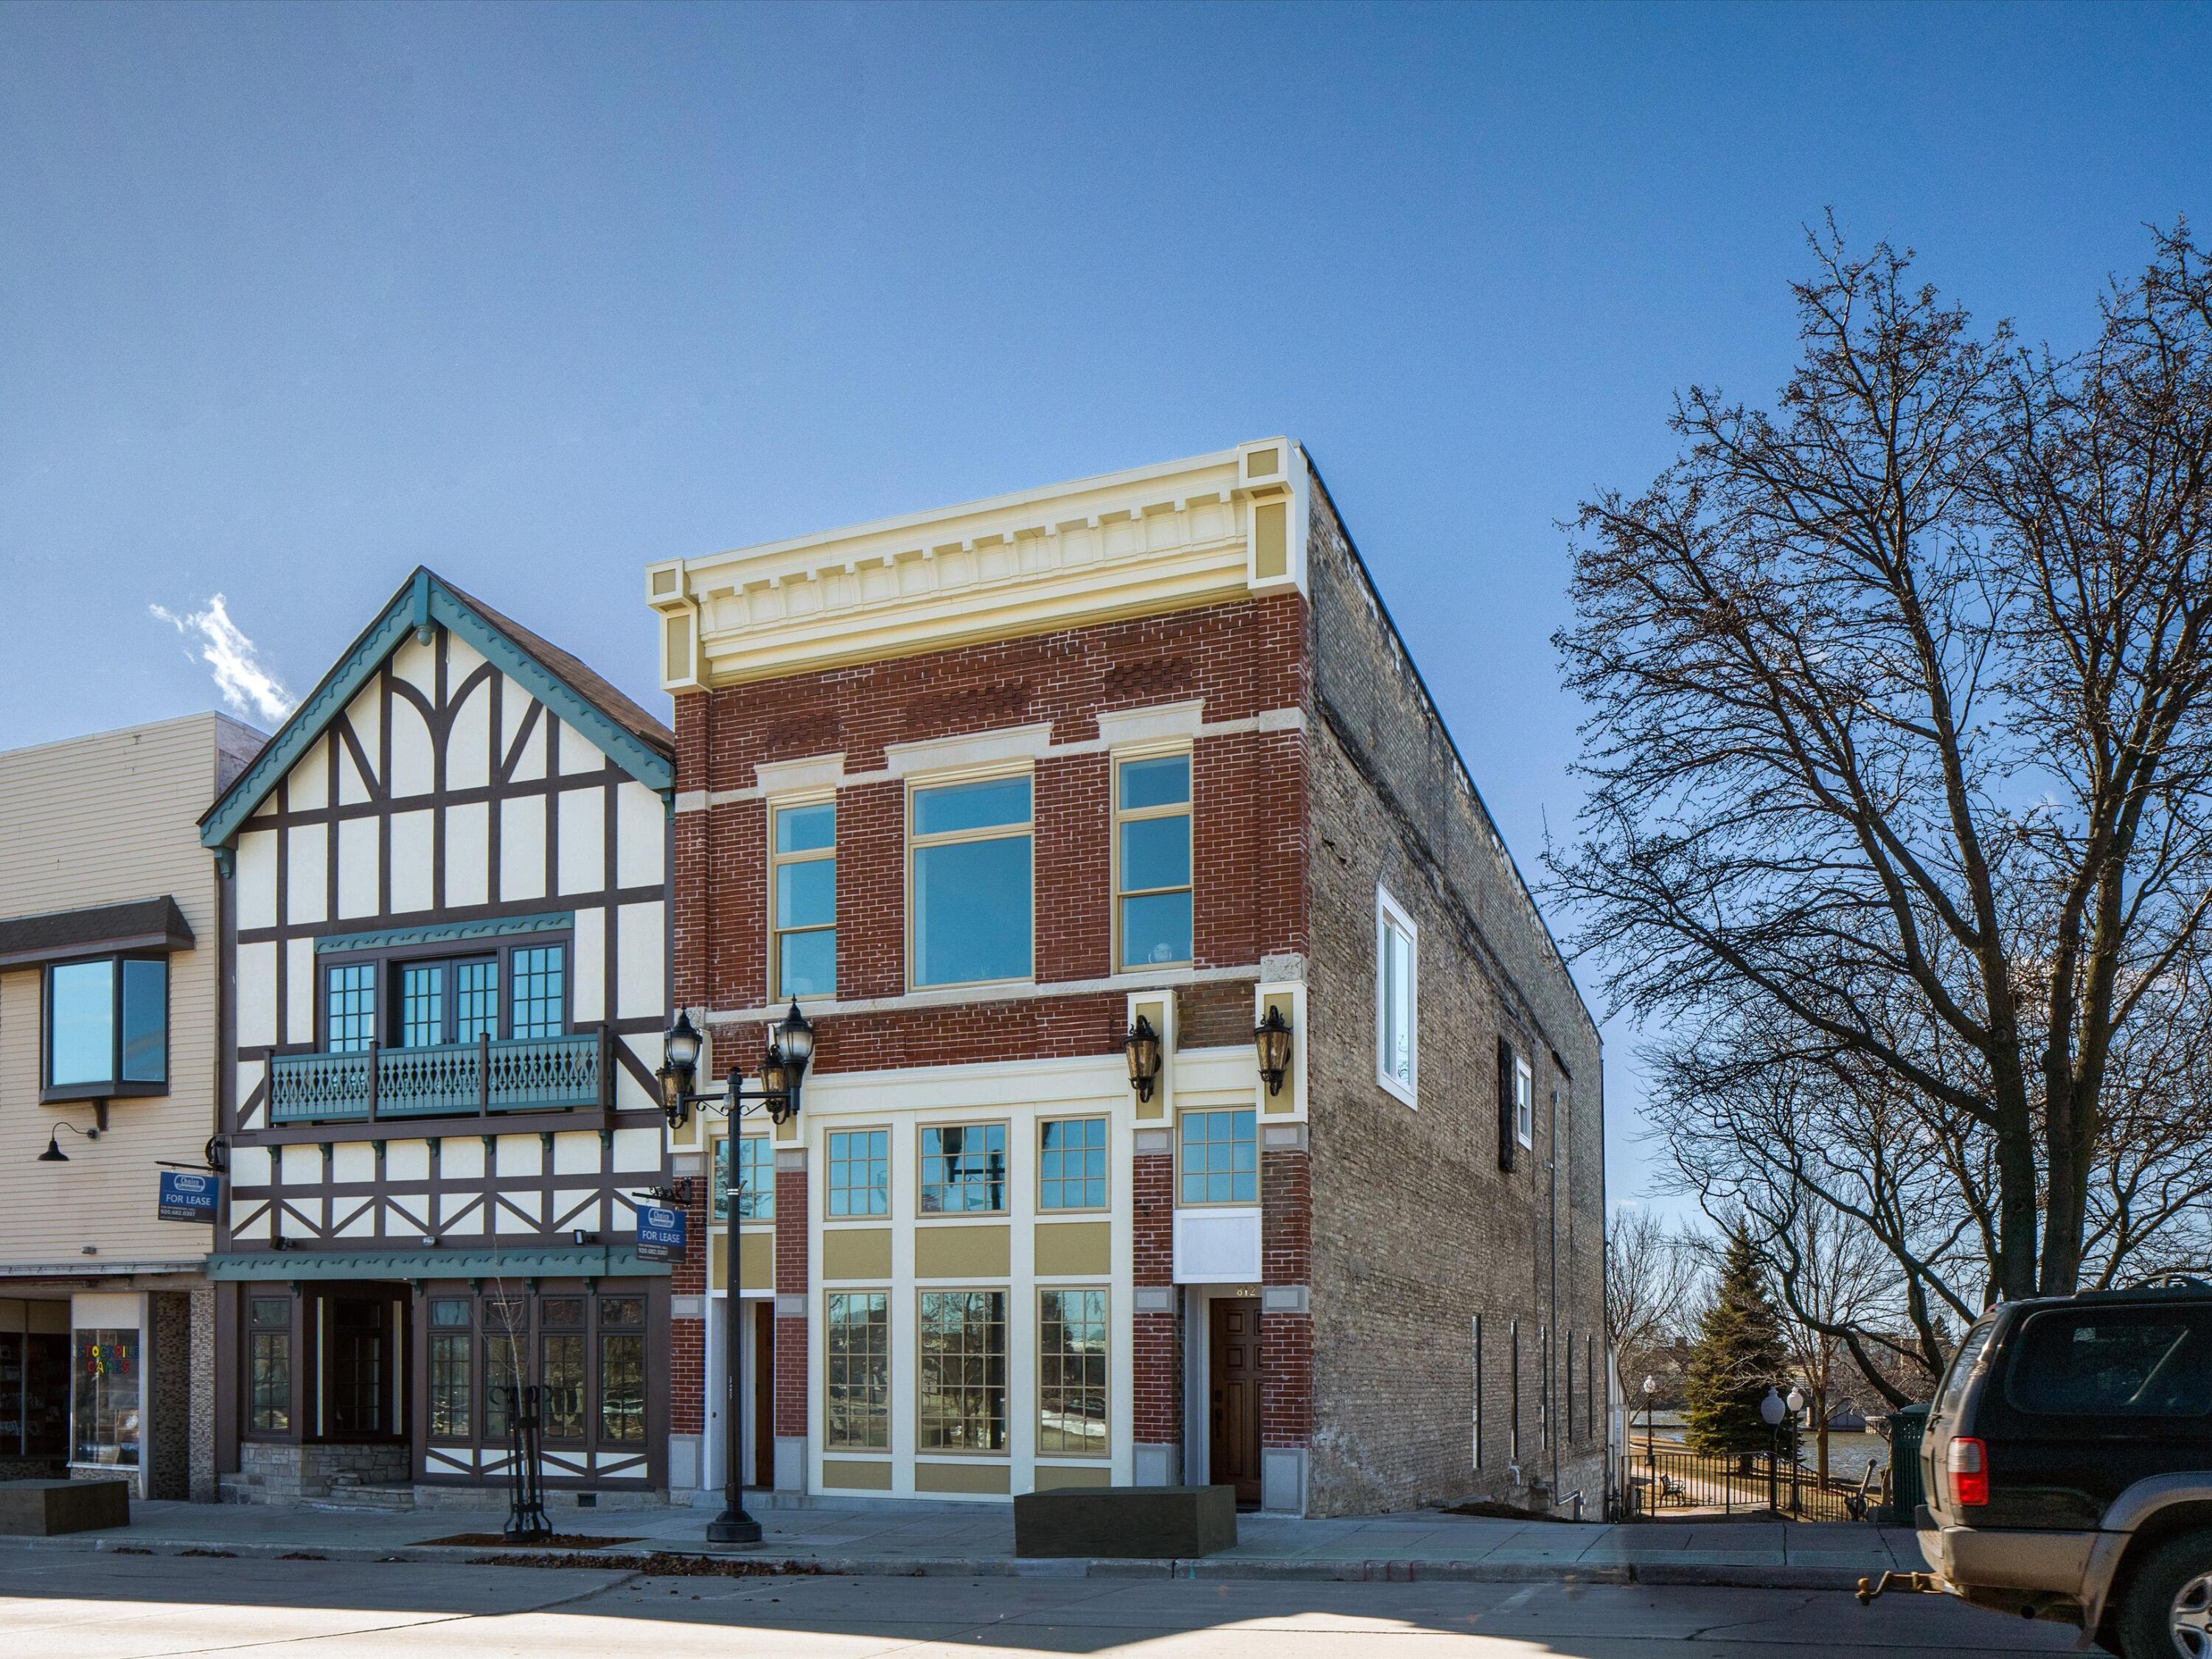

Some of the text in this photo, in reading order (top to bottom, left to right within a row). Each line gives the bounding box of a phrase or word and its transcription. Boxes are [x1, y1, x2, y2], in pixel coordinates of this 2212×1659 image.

[180, 1177, 200, 1186] Choice
[166, 1194, 211, 1206] FOR LEASE
[642, 1230, 681, 1243] FOR LEASE
[1237, 1285, 1256, 1296] 812
[77, 1344, 139, 1359] STOCKPILE
[86, 1360, 130, 1374] GAMES
